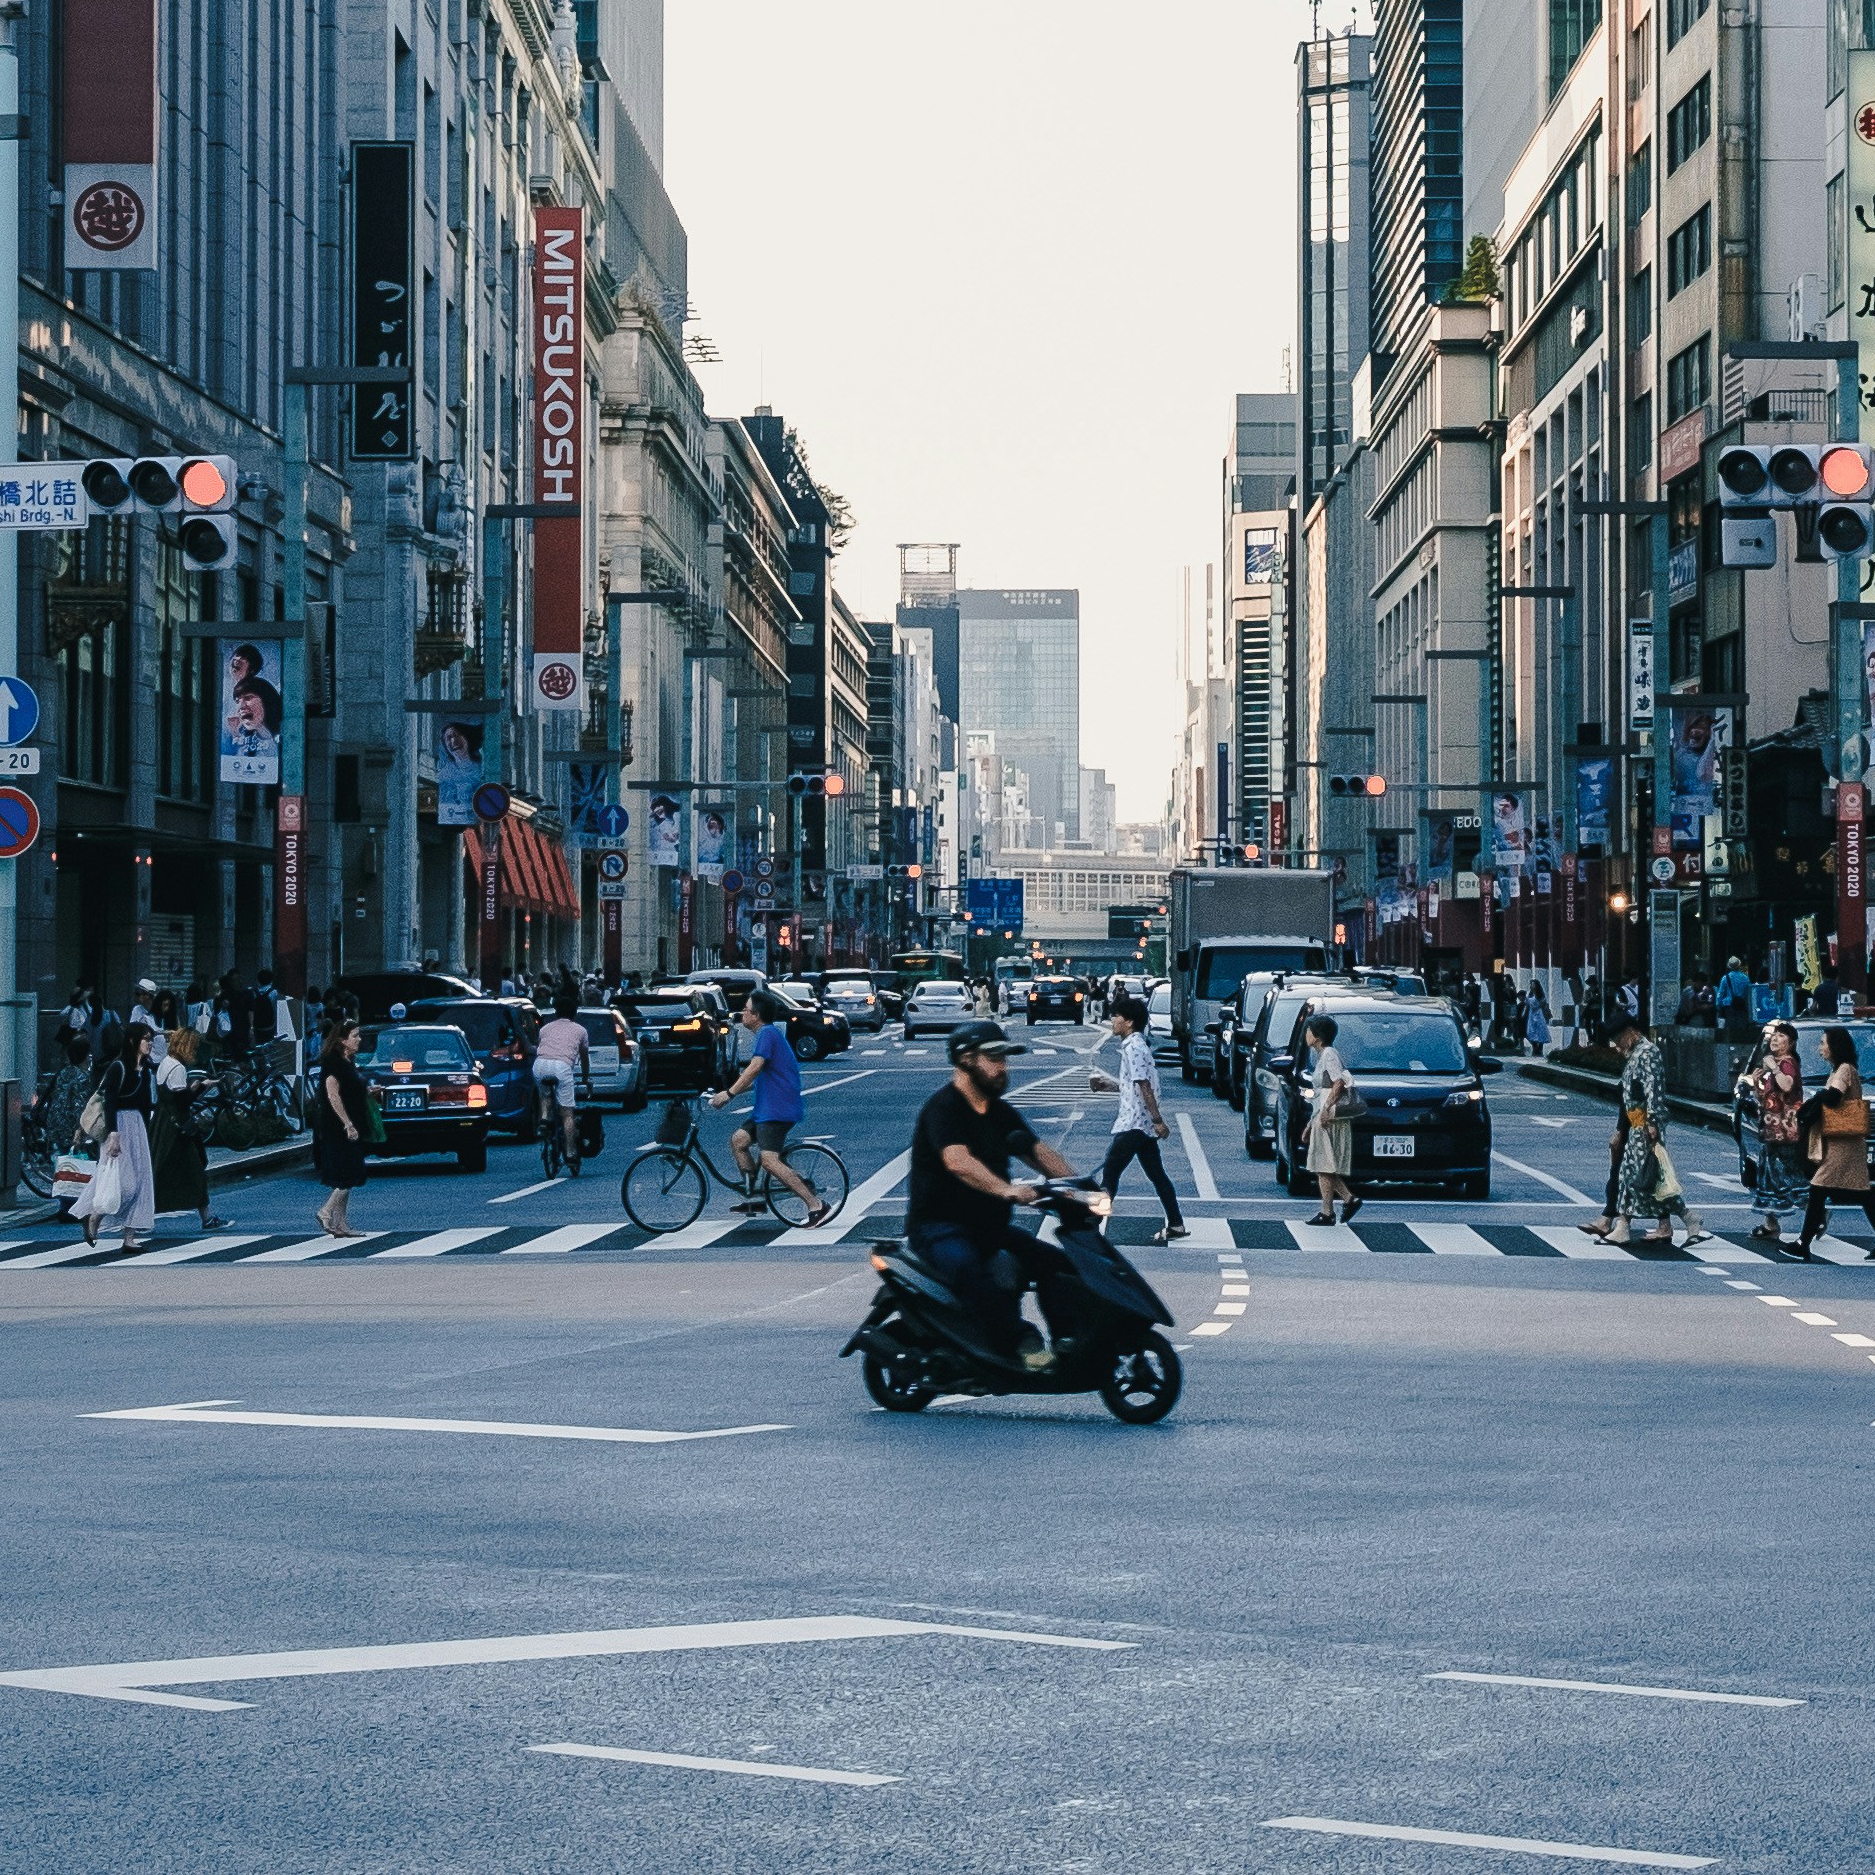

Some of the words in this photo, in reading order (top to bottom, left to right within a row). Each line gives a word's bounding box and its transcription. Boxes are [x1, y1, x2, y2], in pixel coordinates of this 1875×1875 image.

[542, 228, 576, 503] MITSUKOSH
[285, 834, 297, 873] TOKYO
[1846, 823, 1859, 869] TOKYO
[285, 876, 297, 905] 2020
[1847, 871, 1860, 897] 2020
